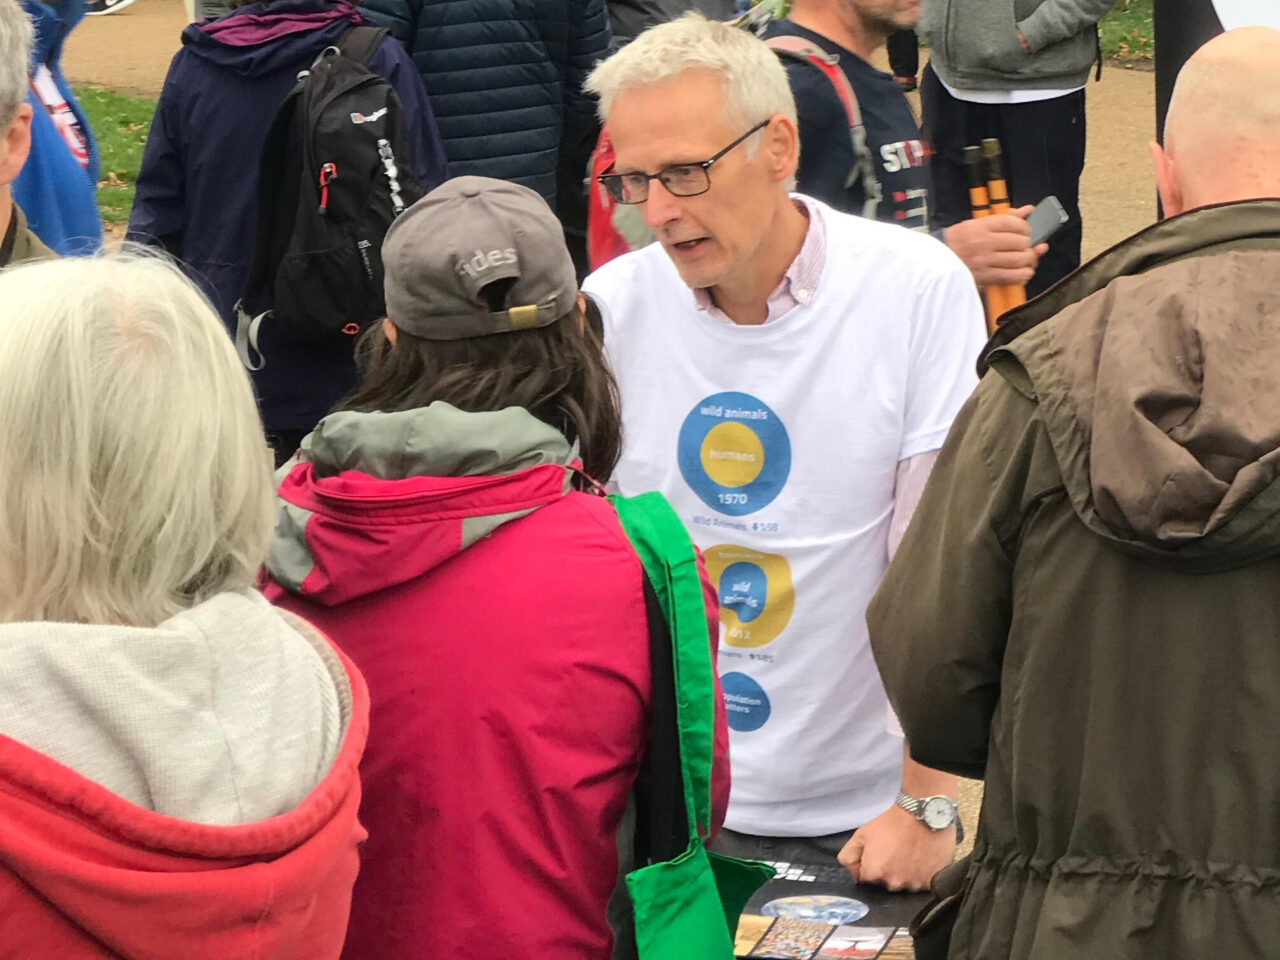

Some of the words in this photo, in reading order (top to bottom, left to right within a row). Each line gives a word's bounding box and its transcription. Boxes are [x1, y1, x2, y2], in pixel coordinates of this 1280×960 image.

[700, 405, 722, 417] wild
[724, 408, 768, 420] animals
[709, 448, 755, 461] humans
[718, 493, 748, 504] 1970
